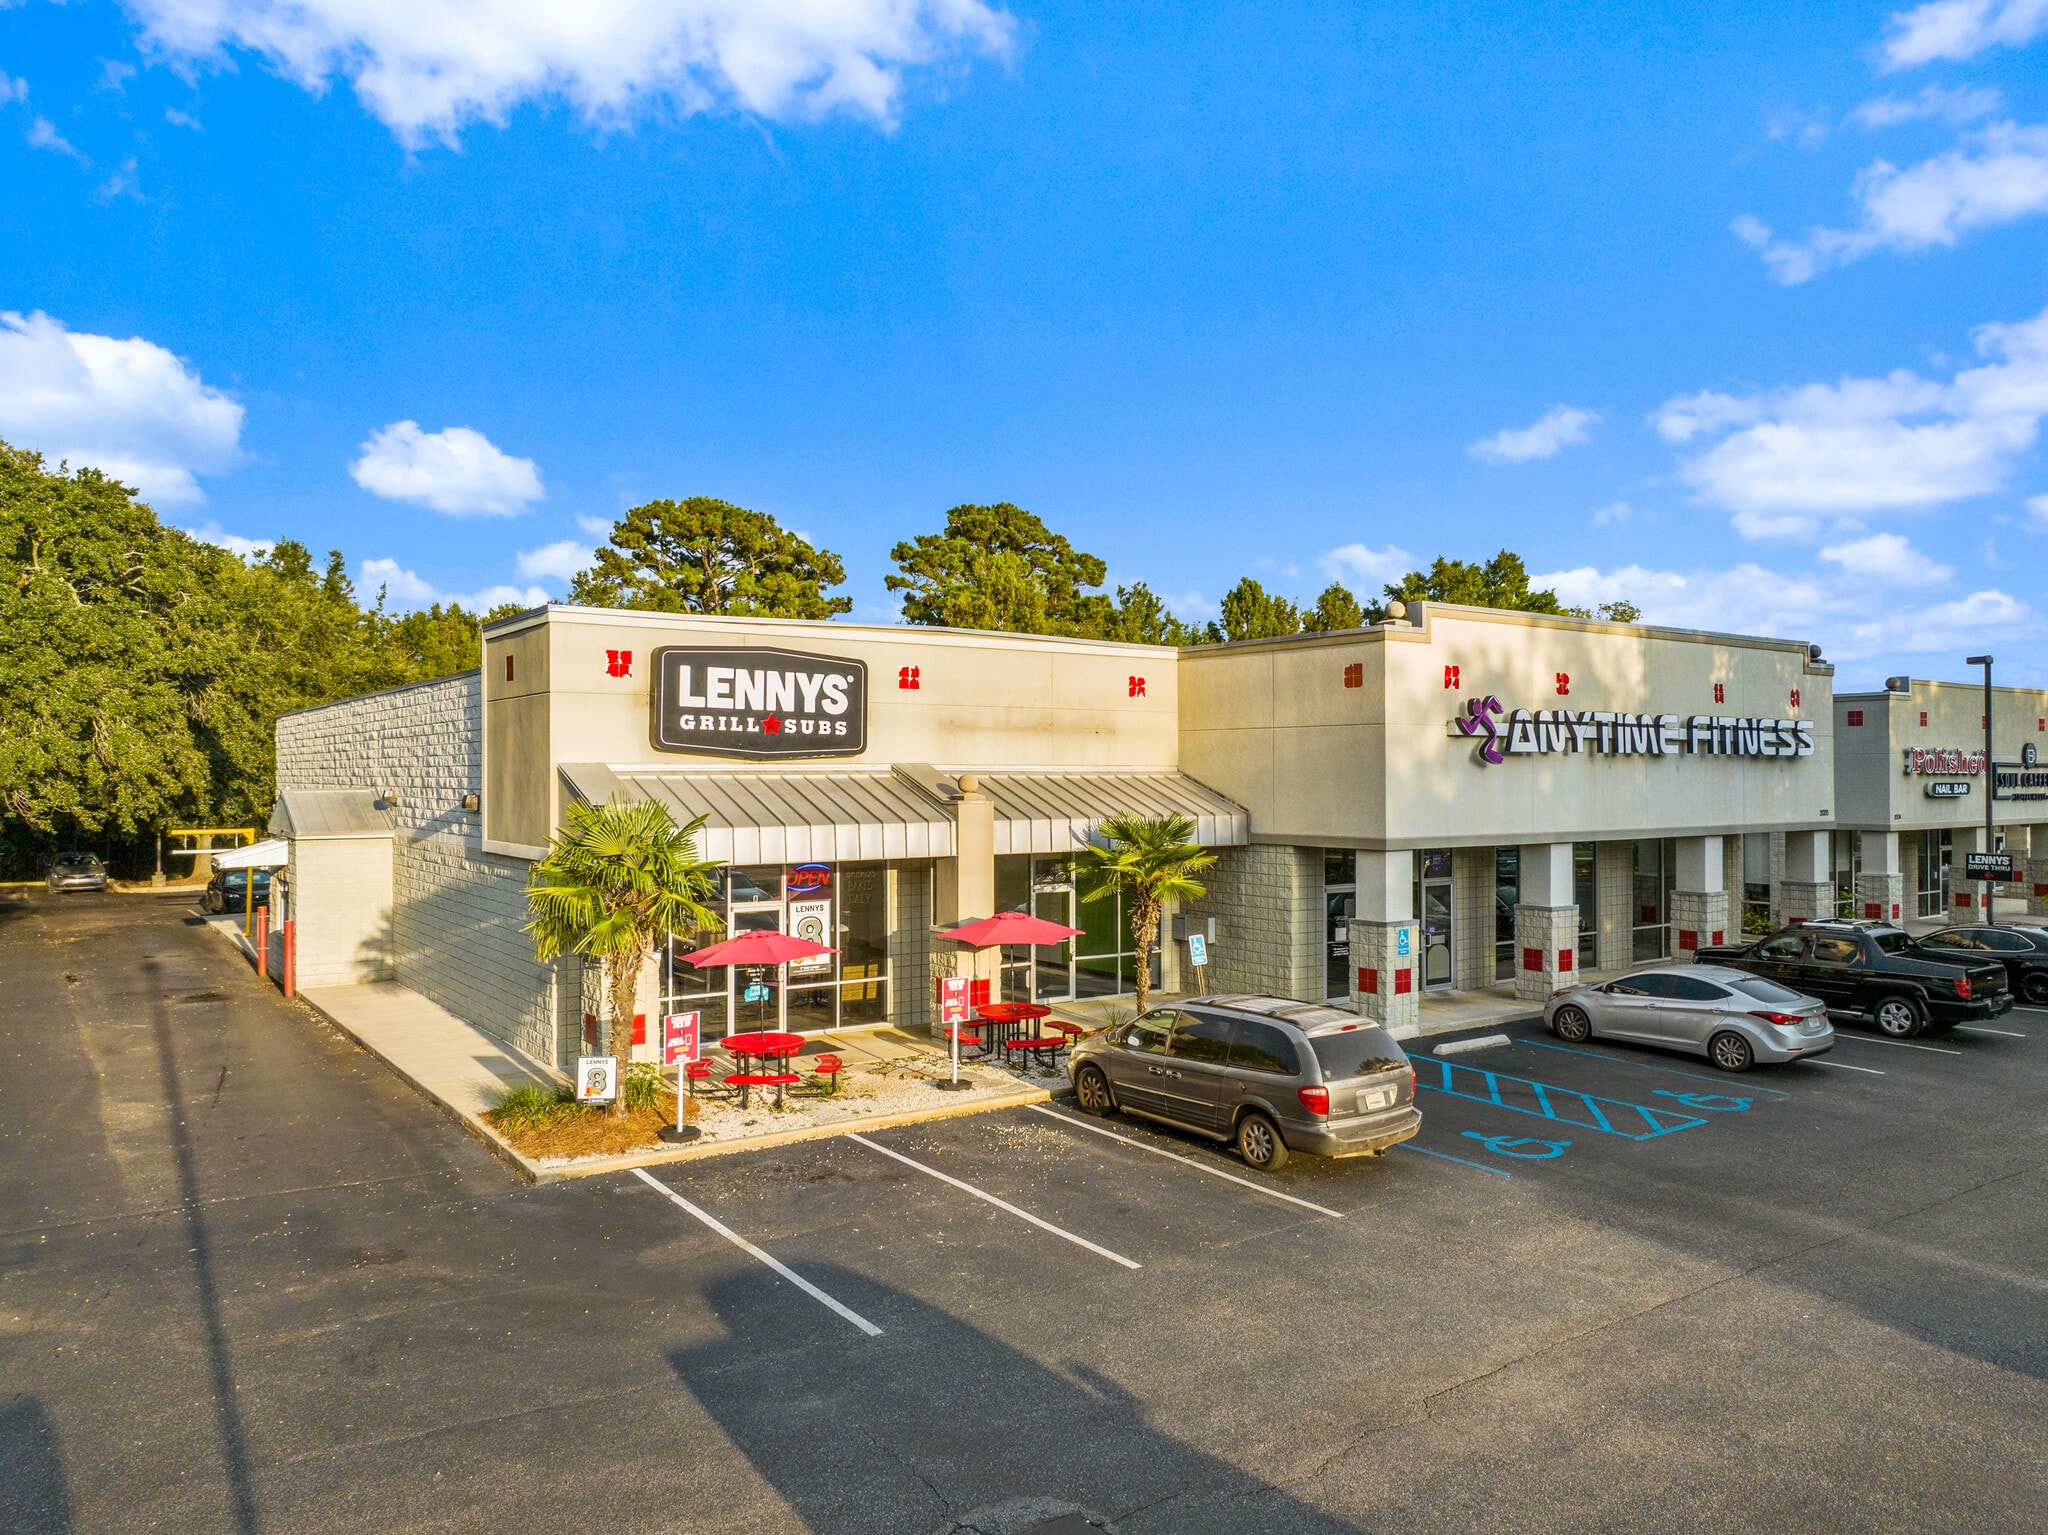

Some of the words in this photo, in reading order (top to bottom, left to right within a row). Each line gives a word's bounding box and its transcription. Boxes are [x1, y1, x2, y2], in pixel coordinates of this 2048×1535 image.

[679, 665, 849, 715] LENNYS
[680, 714, 760, 733] GRILL
[784, 719, 848, 736] SUBS
[1505, 708, 1679, 754] ANYTIME
[1687, 715, 1815, 756] FITNESS
[1911, 747, 1986, 774] Polished
[1935, 784, 1952, 794] NAIL
[1953, 784, 1968, 794] BAR
[1968, 855, 2011, 866] LENNYS
[786, 869, 831, 886] OPEN
[587, 1067, 607, 1093] 8
